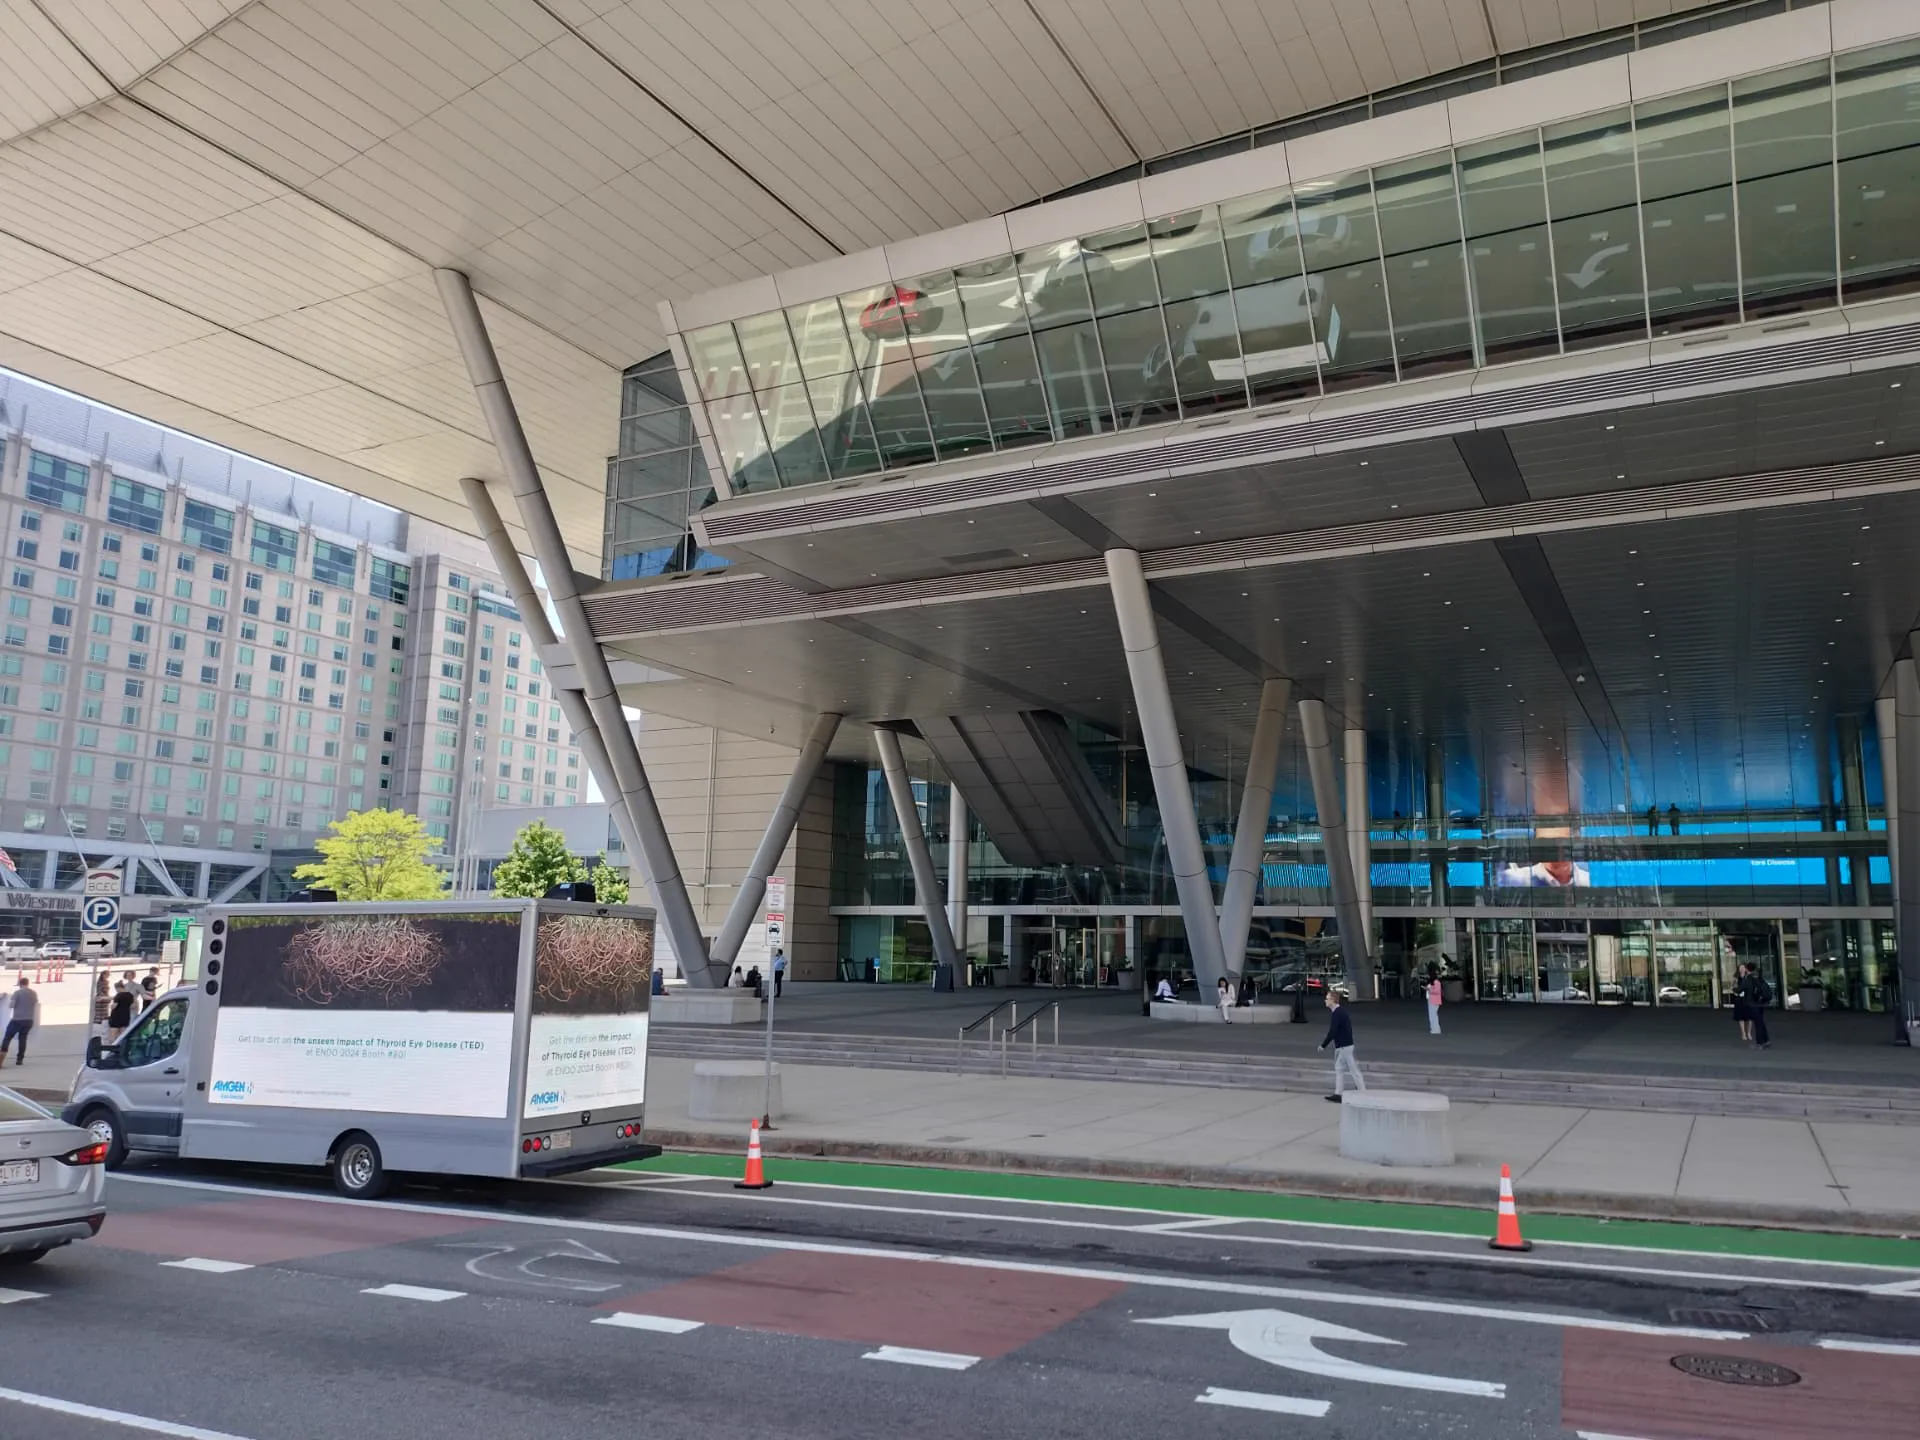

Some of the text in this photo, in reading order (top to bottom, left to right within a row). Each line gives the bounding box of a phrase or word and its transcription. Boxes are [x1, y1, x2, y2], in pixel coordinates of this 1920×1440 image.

[88, 881, 119, 892] BCEC
[7, 893, 77, 910] WESTIN
[92, 902, 112, 924] P
[293, 1036, 306, 1044] the
[336, 1037, 363, 1046] impact
[365, 1038, 375, 1047] of
[376, 1038, 407, 1048] Thyroid
[409, 1039, 424, 1049] Eye
[426, 1039, 458, 1049] Disease
[460, 1040, 485, 1051] (TED)
[598, 1034, 609, 1042] the
[610, 1032, 632, 1042] impact
[362, 1049, 386, 1058] Booth
[541, 1046, 636, 1061] of Thyroid Eye Disease (TED)
[212, 1080, 246, 1093] AMGEN
[530, 1091, 560, 1105] AMGEN
